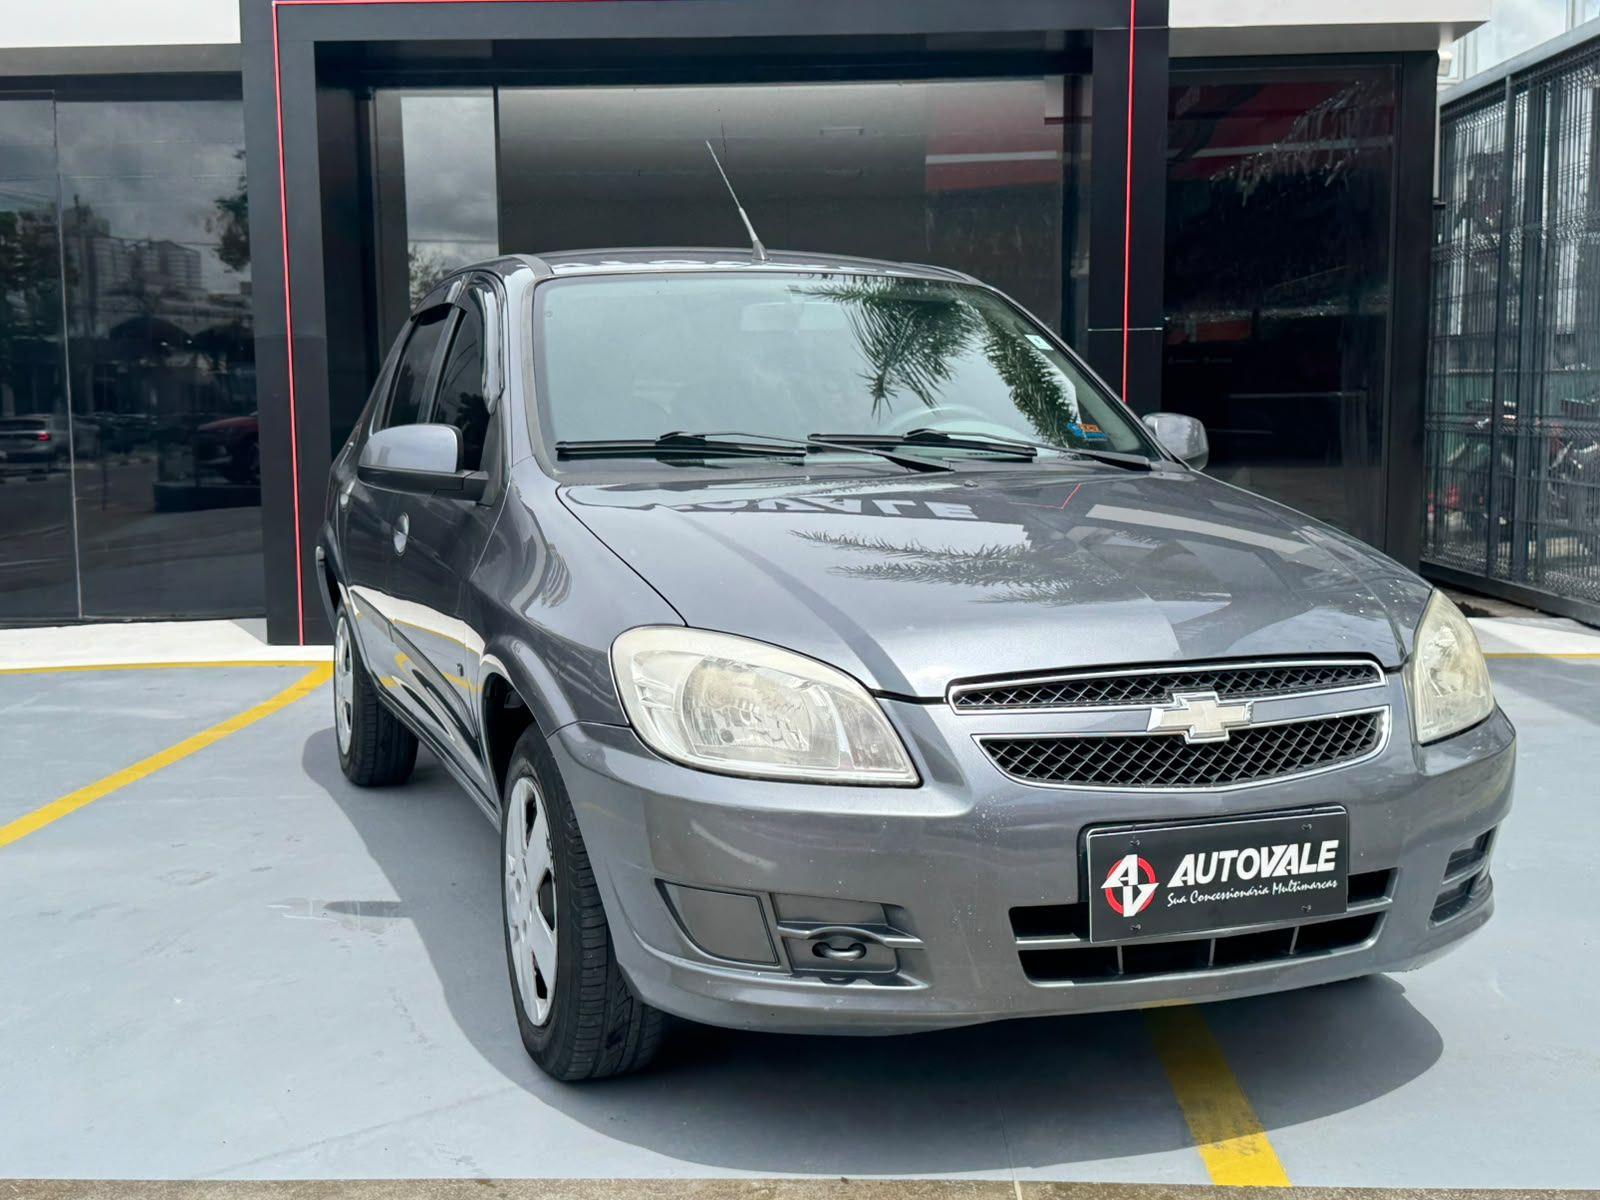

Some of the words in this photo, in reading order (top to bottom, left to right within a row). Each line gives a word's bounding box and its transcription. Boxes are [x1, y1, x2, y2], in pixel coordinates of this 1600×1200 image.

[1101, 854, 1160, 918] AV
[1166, 839, 1339, 888] AUTOVALE
[1167, 892, 1187, 908] Sua
[1190, 884, 1270, 904] Concessionária
[1272, 879, 1339, 896] Multimarcas
